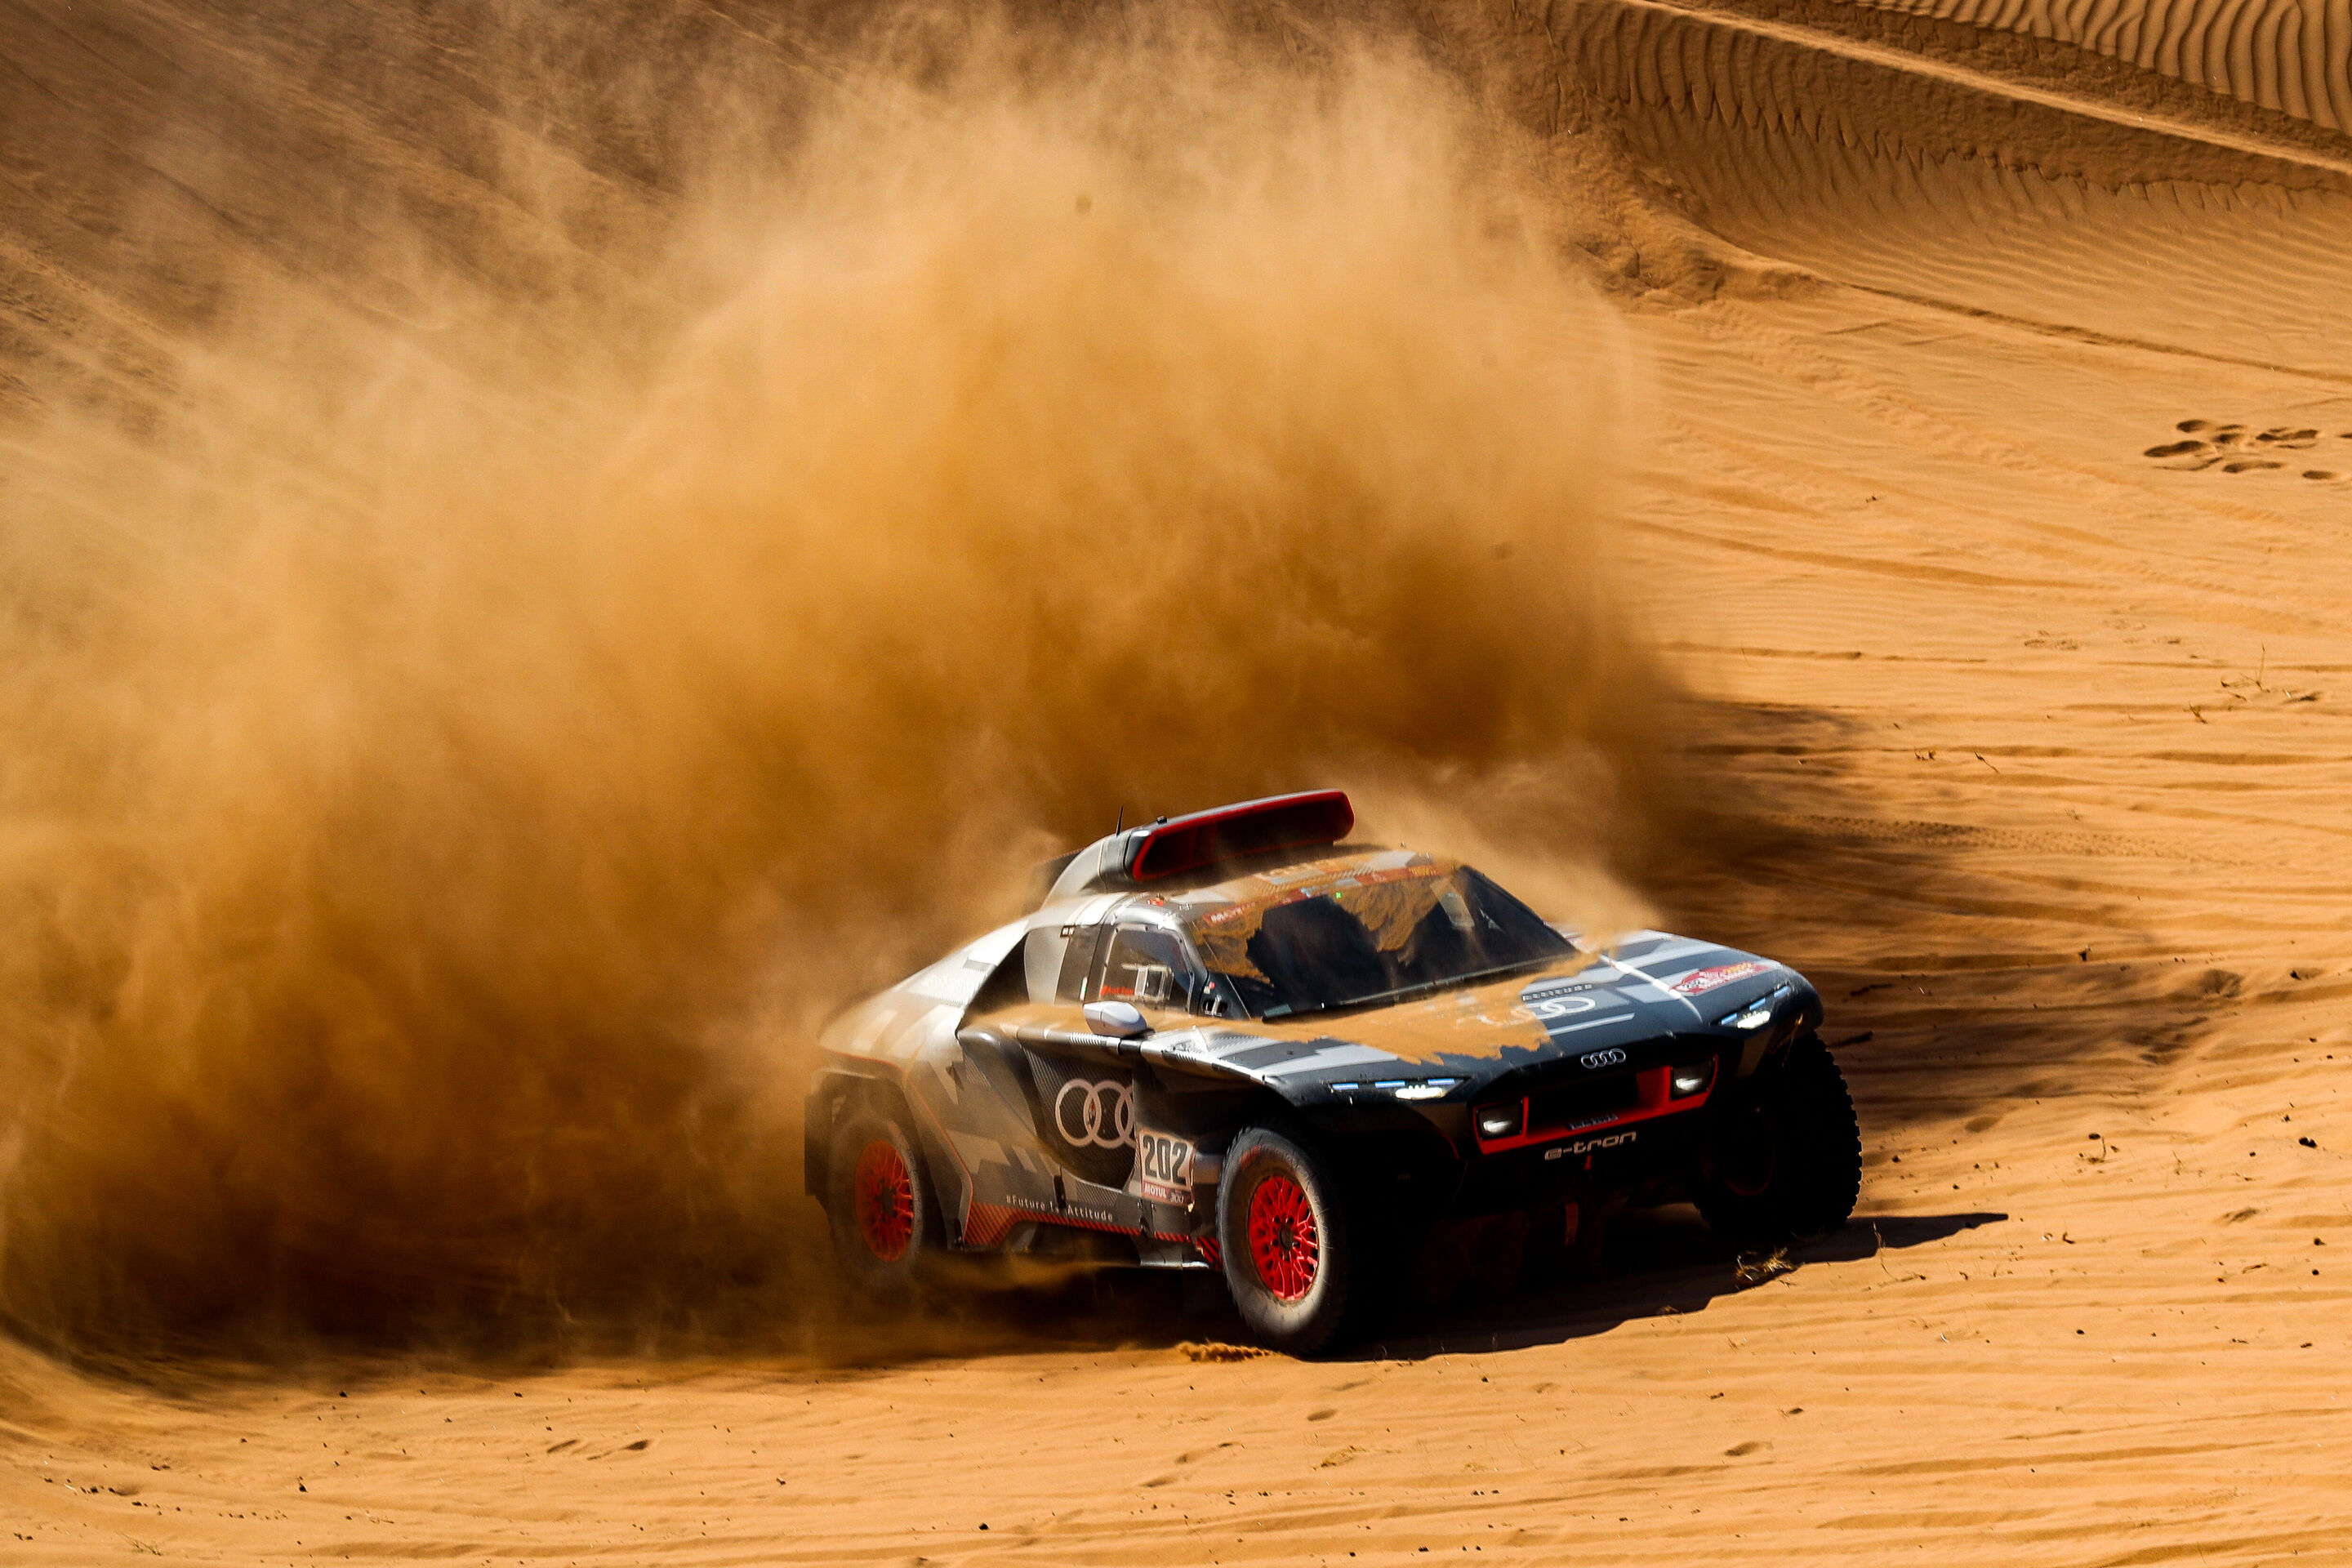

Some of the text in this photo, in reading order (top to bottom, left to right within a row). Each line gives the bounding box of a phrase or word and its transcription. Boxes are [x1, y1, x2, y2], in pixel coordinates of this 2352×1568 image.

[1143, 1135, 1187, 1183] 202
[1544, 1130, 1637, 1161] e-tron
[1144, 1183, 1167, 1198] MOTUL
[1006, 1195, 1046, 1212] #Future
[1067, 1205, 1113, 1222] Attitude
